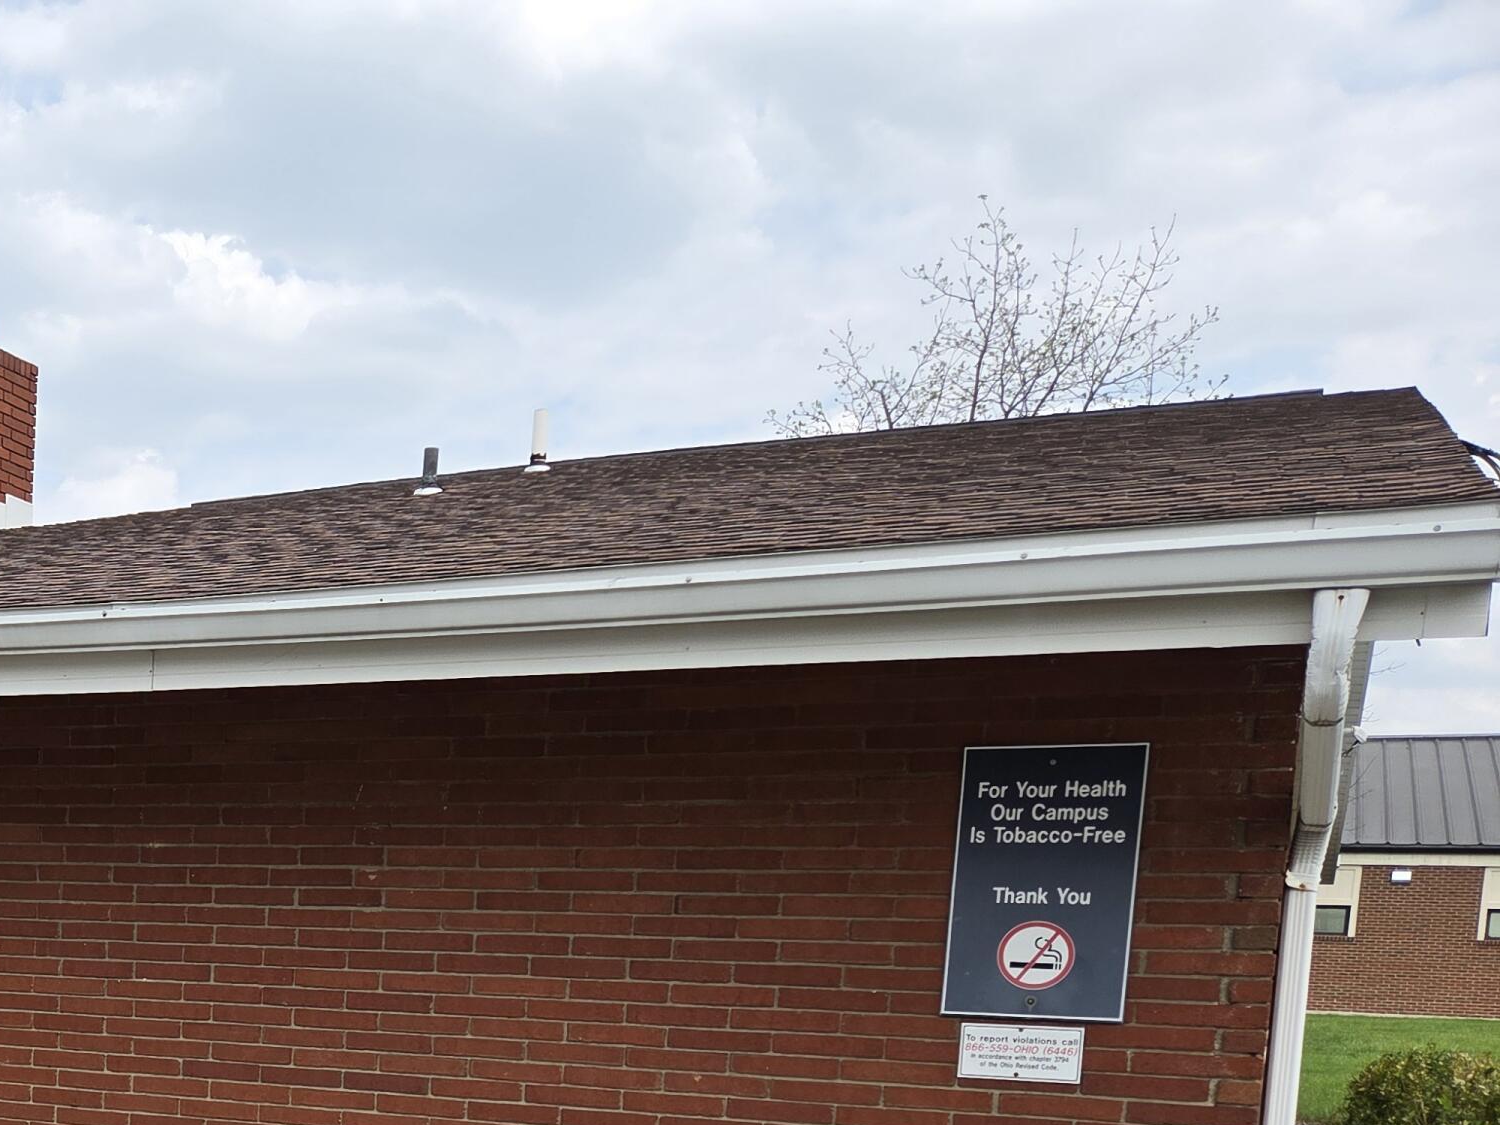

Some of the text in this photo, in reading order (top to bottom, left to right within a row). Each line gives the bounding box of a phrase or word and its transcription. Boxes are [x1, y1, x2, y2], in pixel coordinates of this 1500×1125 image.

[977, 780, 1127, 799] For Your Health
[990, 803, 1109, 824] Our Campus
[969, 826, 1126, 844] Is Tobacco-Free
[992, 886, 1091, 905] Thank You
[966, 1034, 1078, 1046] To report violations call
[965, 1042, 1078, 1057] 866-559-OHIO (6446)
[1015, 1062, 1039, 1070] Revised
